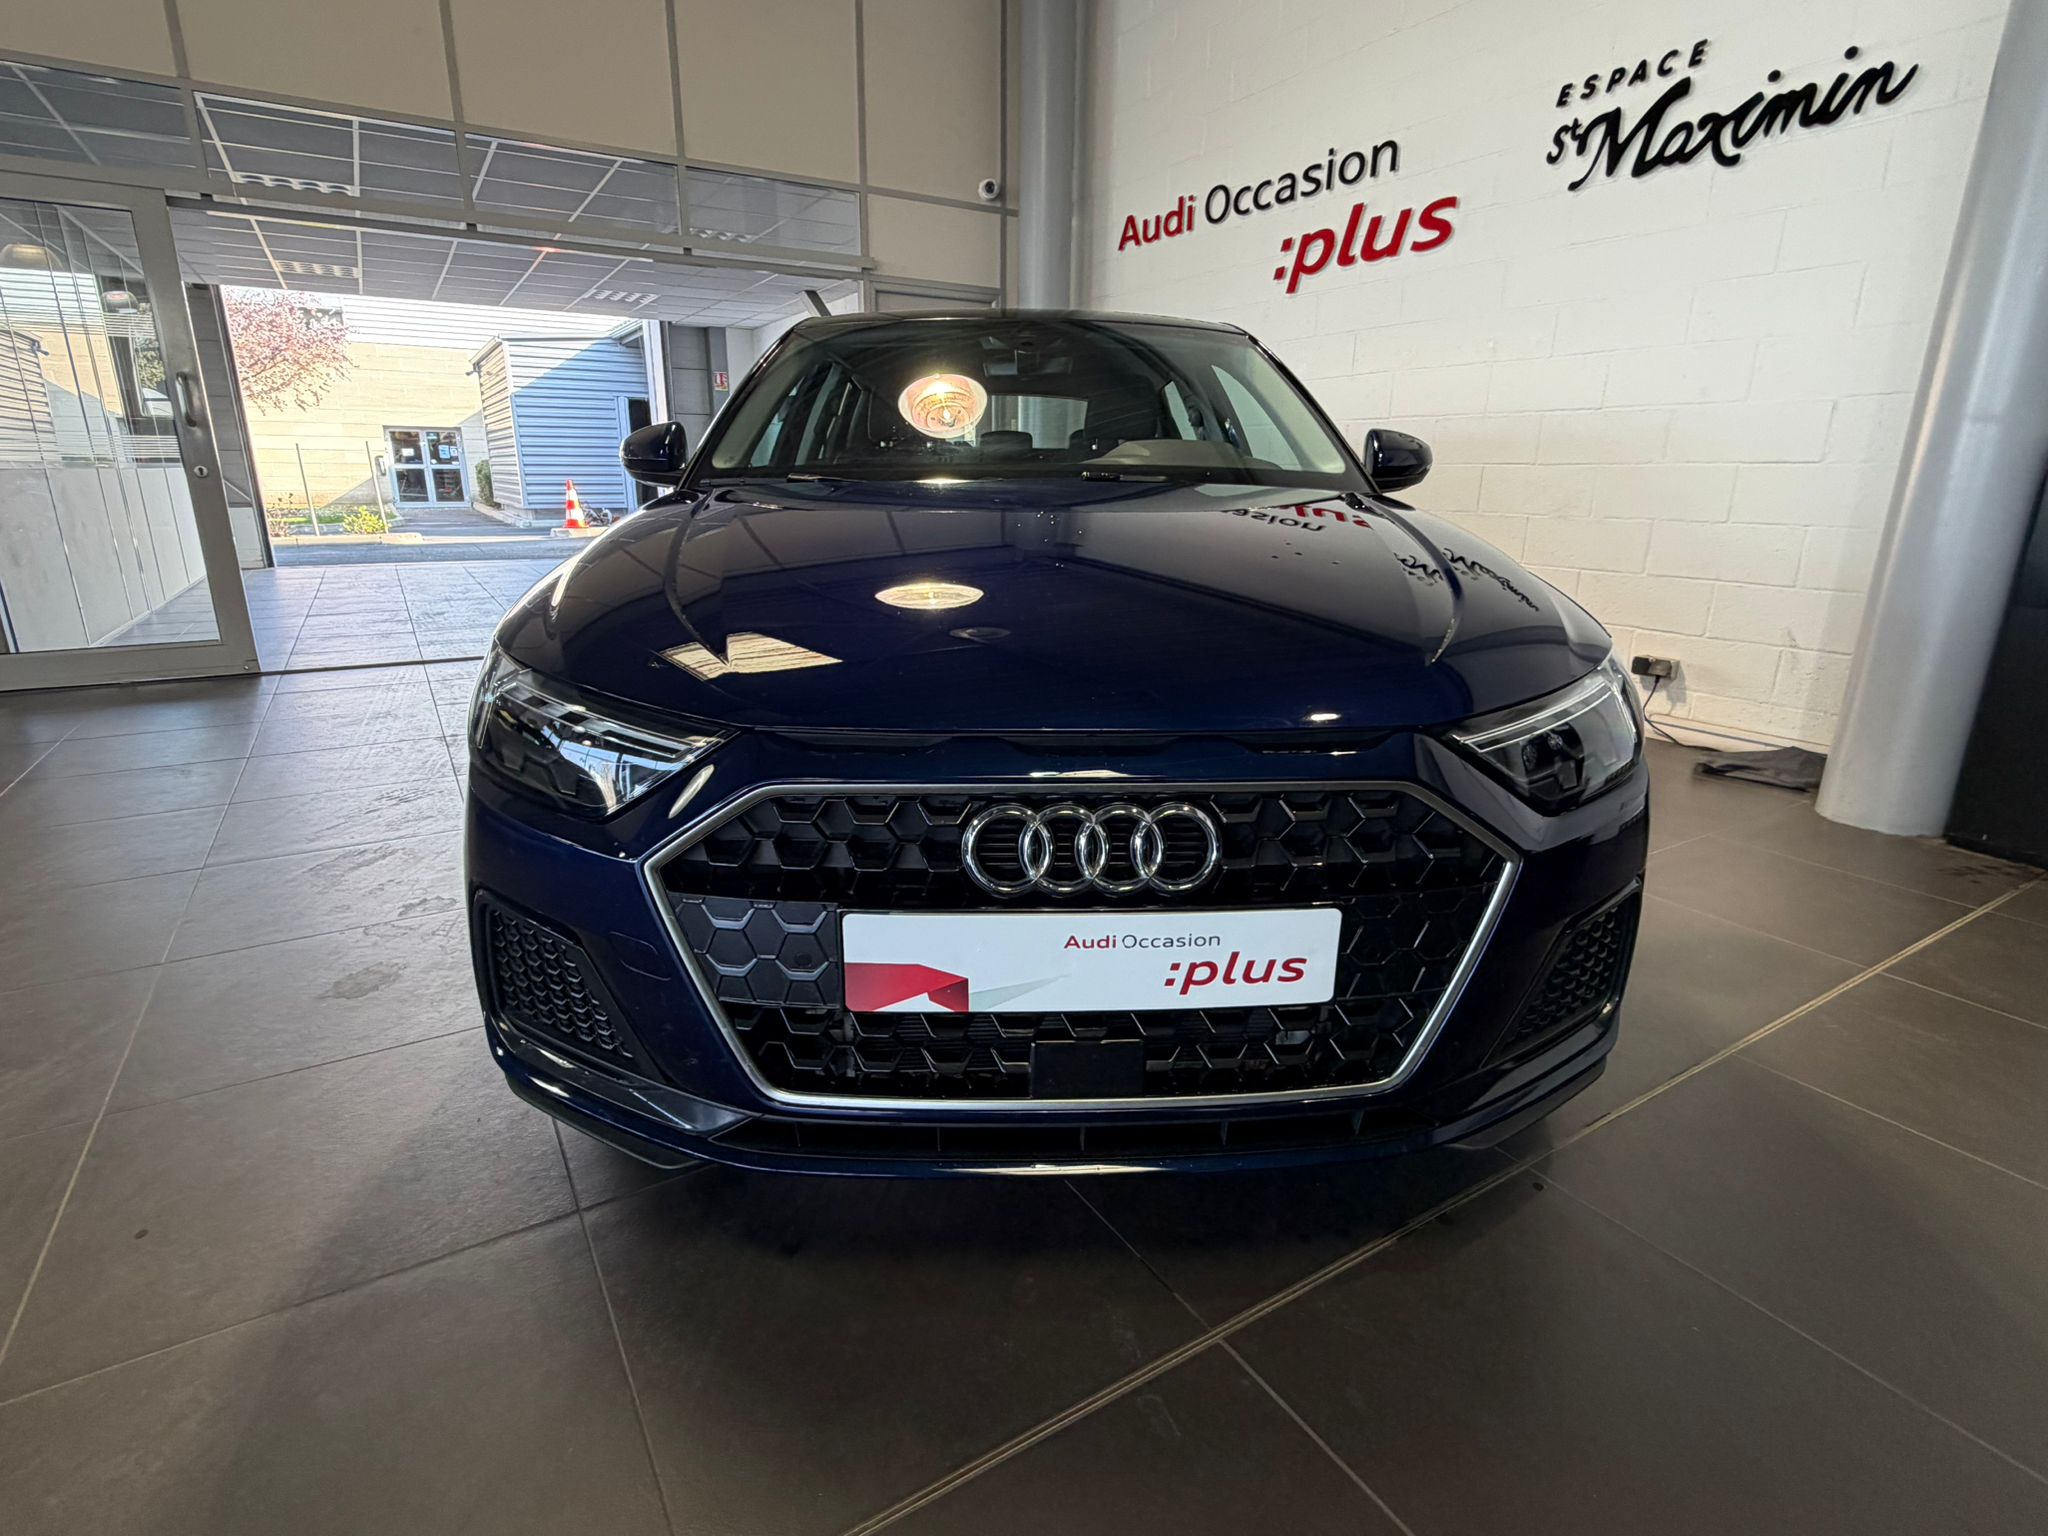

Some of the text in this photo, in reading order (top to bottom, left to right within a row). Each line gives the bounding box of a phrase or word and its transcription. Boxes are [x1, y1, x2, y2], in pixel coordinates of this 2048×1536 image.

[1555, 38, 1708, 108] ESPACE
[1567, 45, 1919, 192] Maximin
[1119, 140, 1399, 252] Audi Occasion
[1275, 197, 1458, 295] :plus
[1063, 933, 1221, 949] Audi Occasion
[1164, 951, 1308, 996] :plus
